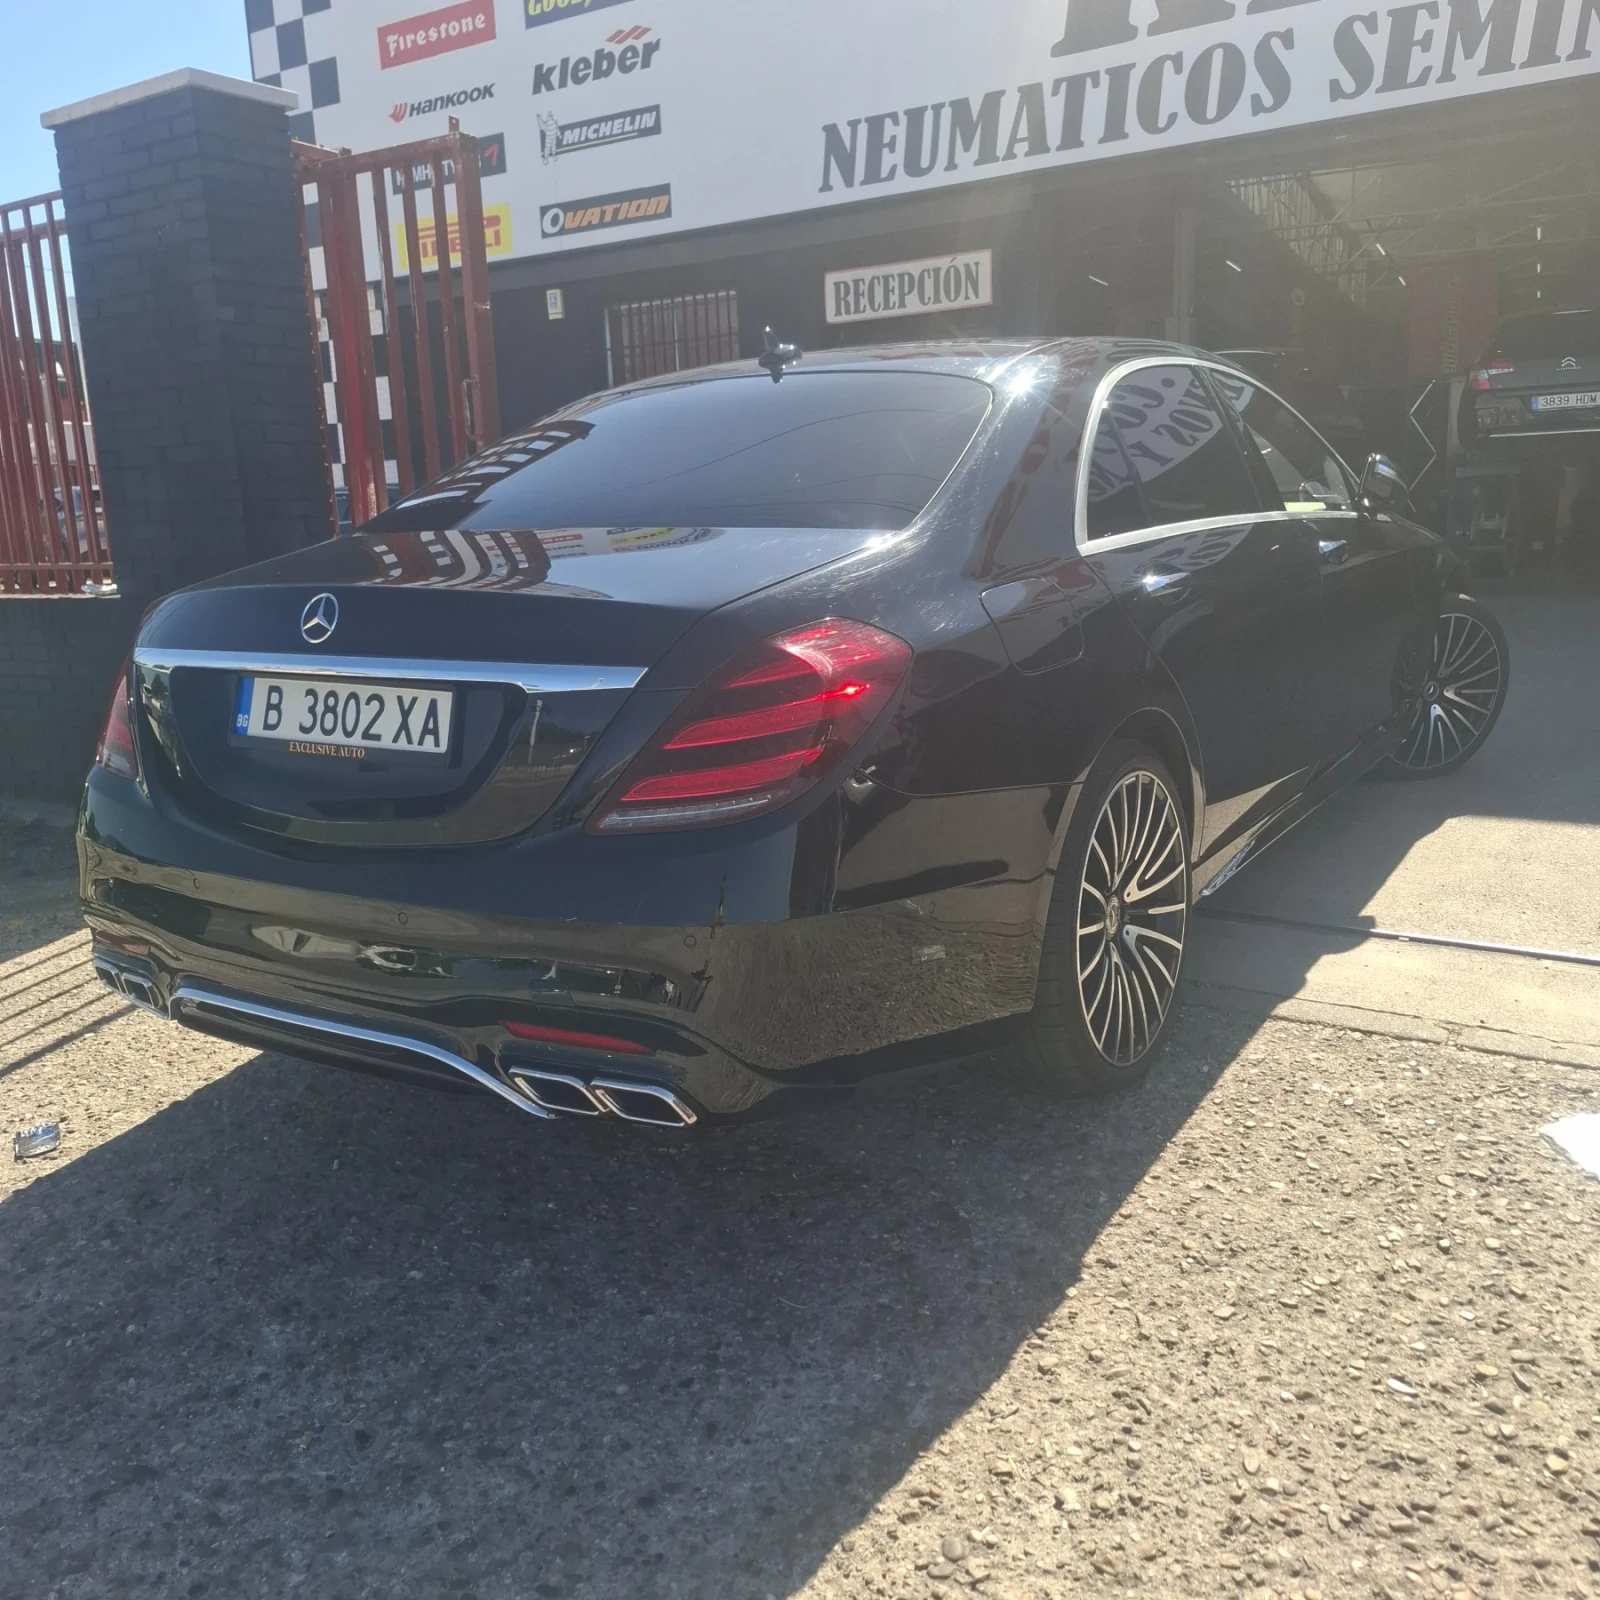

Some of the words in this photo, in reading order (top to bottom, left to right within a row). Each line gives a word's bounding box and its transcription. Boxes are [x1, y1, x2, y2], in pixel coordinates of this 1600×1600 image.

[386, 12, 486, 58] Firestone
[532, 37, 662, 96] kleber
[562, 111, 657, 145] MICHELIN
[818, 27, 1295, 193] NEUMATICOS
[542, 195, 670, 234] OVATION
[832, 257, 981, 317] RECEPCIÓN
[1541, 395, 1570, 408] 3839
[1575, 394, 1597, 405] HDM
[236, 714, 249, 728] BG
[262, 685, 284, 731] B
[289, 741, 337, 757] EXCLUSIVE
[339, 746, 365, 758] AUTO
